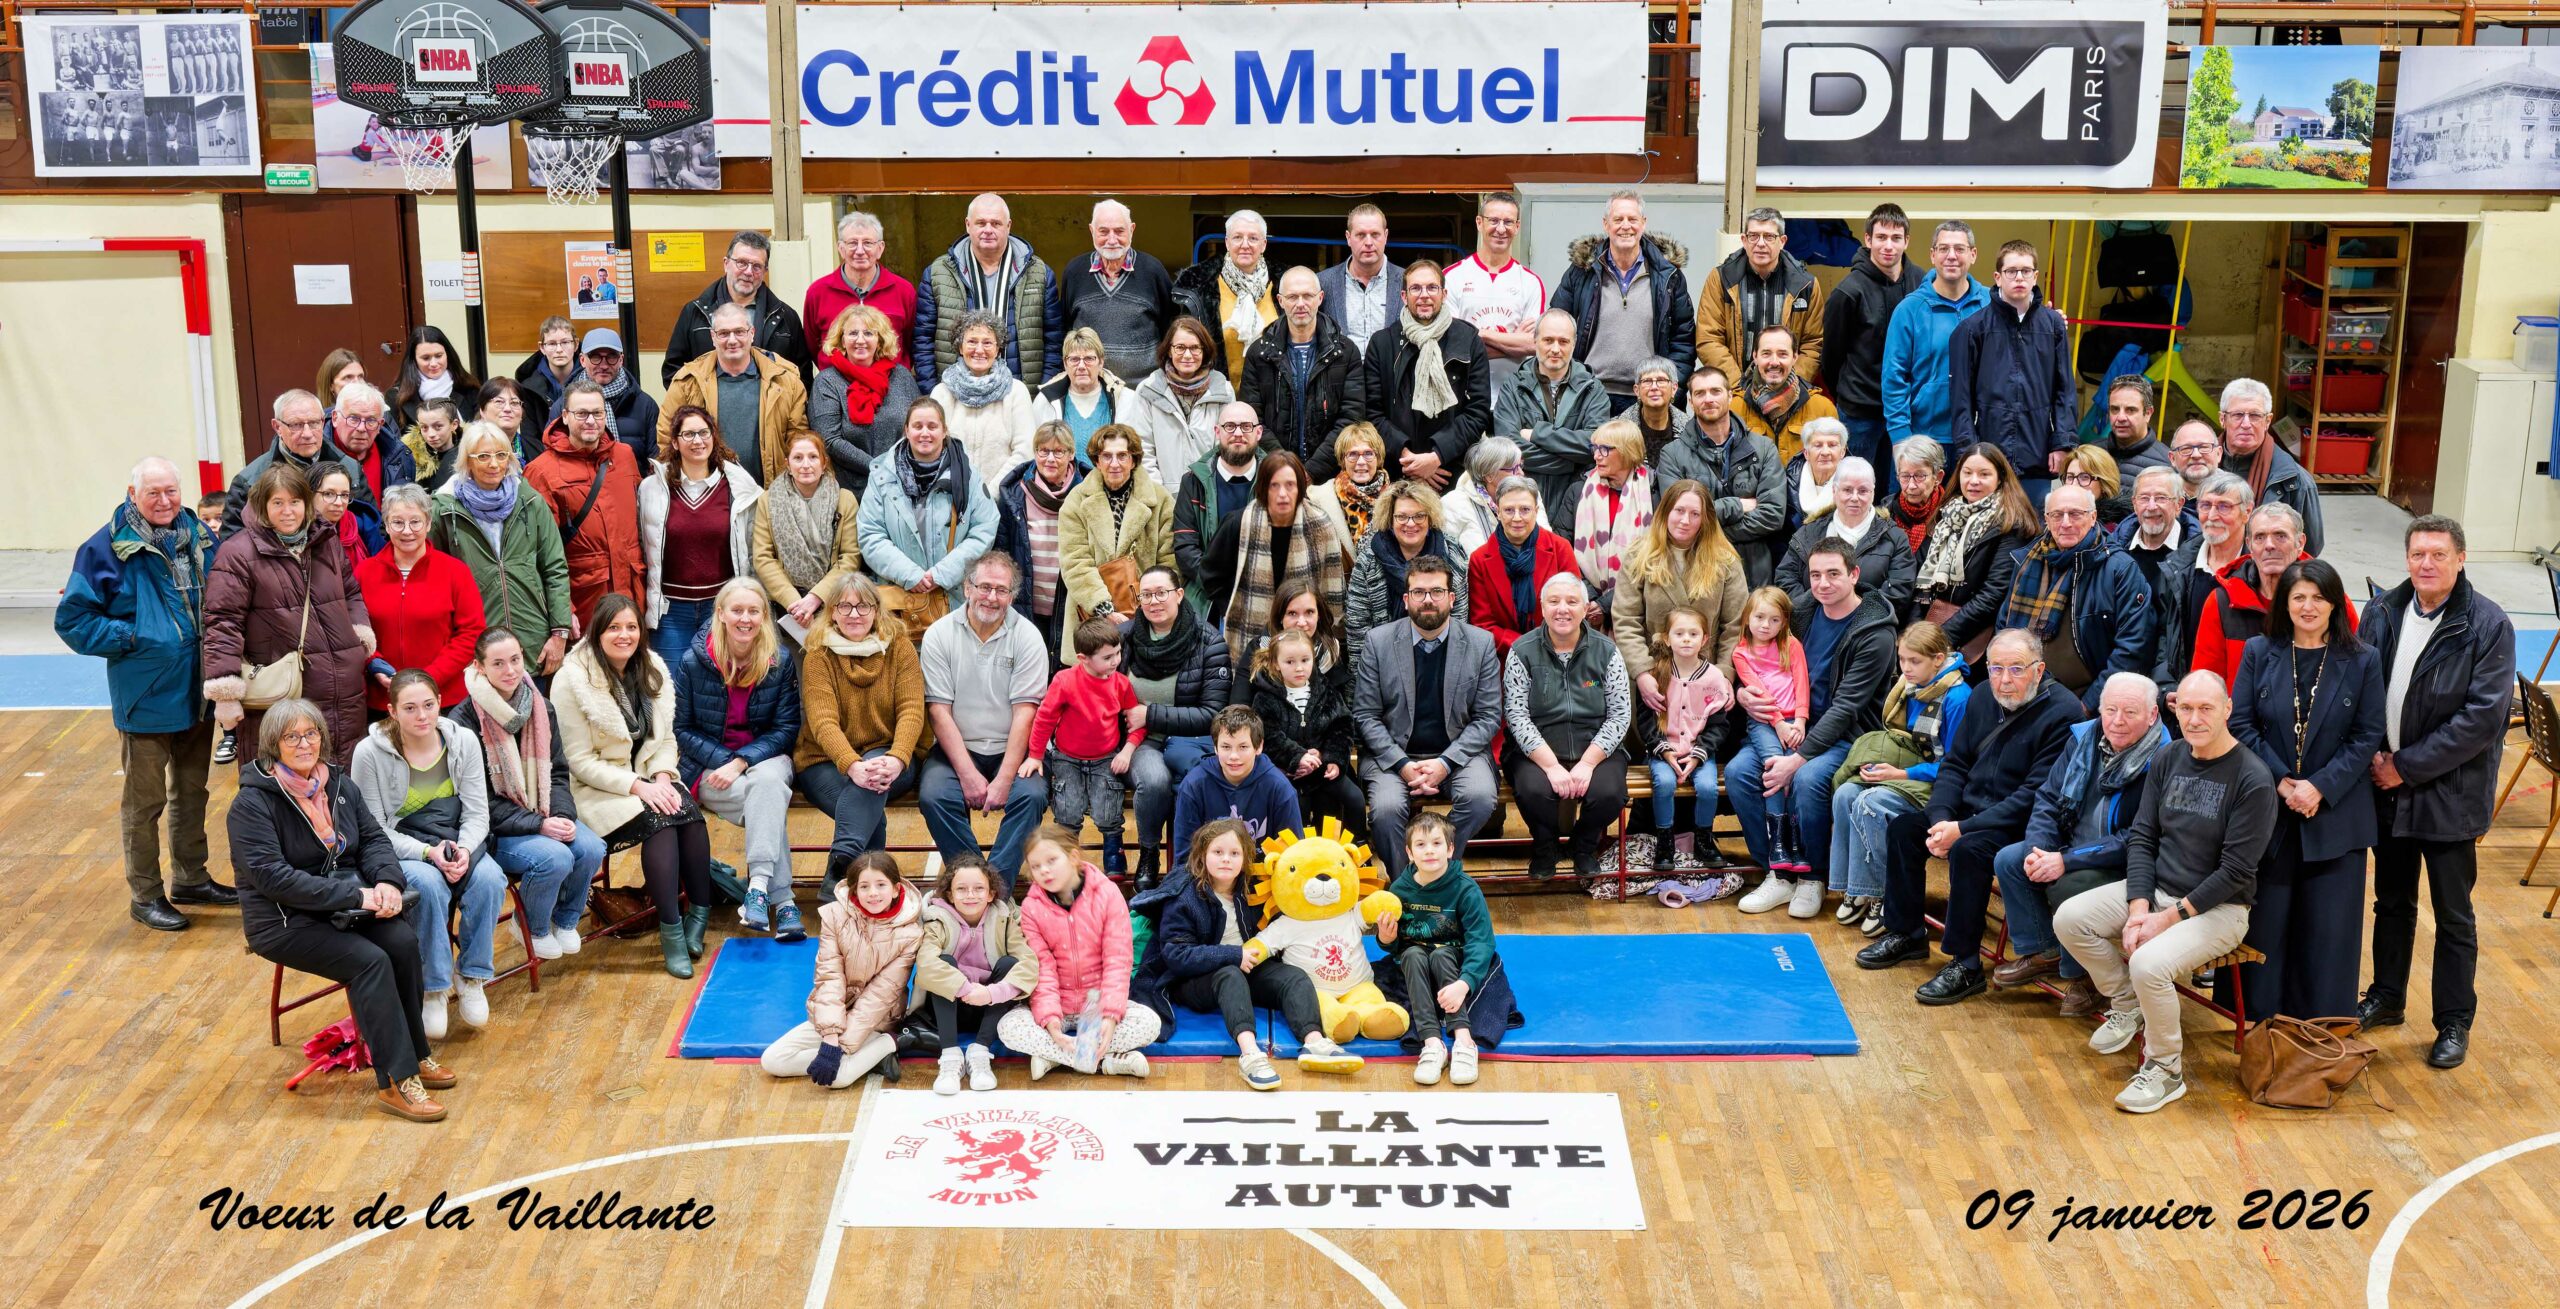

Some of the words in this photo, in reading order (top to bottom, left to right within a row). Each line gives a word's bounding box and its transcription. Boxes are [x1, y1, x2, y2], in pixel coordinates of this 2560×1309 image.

[430, 48, 472, 72] NBA
[584, 63, 625, 86] NBA
[351, 82, 398, 94] SPALDING
[495, 83, 542, 95] SPALDING
[801, 49, 1100, 127] Crédit
[1234, 48, 1560, 125] Mutuel
[1784, 46, 2075, 141] DIM
[2081, 46, 2106, 141] PARIS
[646, 98, 692, 111] SPALDING
[1320, 964, 1347, 976] AUTUN
[1771, 945, 1795, 971] DIMA
[1315, 1110, 1419, 1133] LA
[885, 1134, 929, 1160] LA
[922, 1109, 1104, 1161] VAILLANTE
[1133, 1142, 1606, 1168] VAILLANTE
[928, 1186, 1040, 1207] AUTUN
[1225, 1183, 1512, 1209] AUTUN
